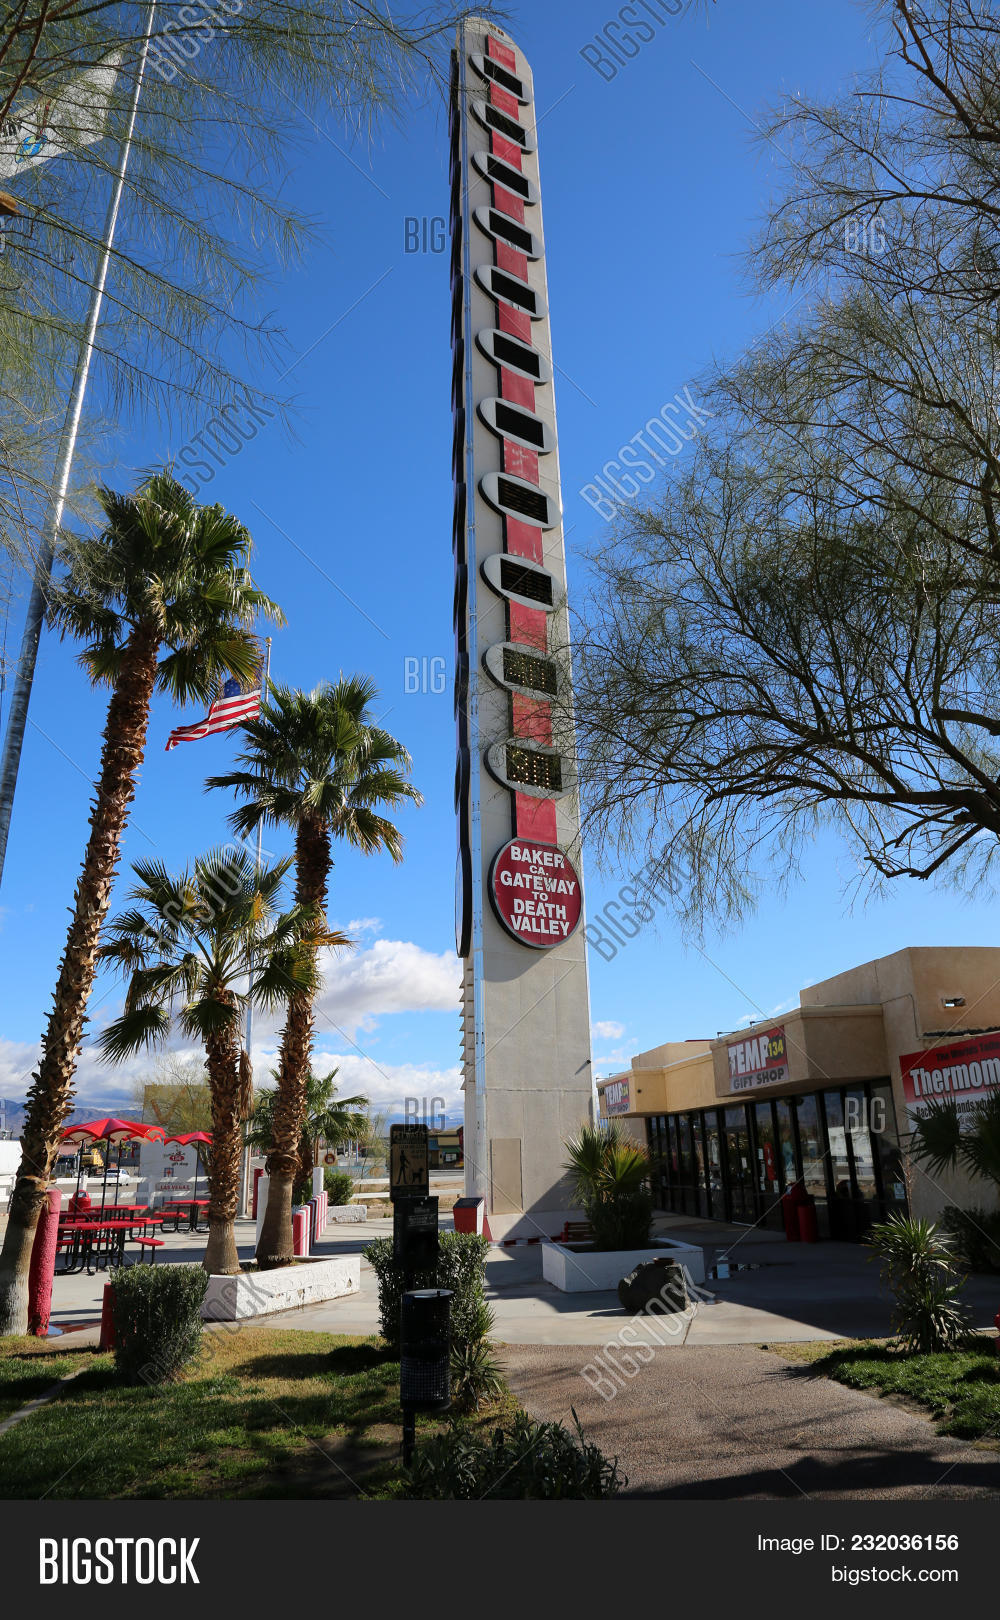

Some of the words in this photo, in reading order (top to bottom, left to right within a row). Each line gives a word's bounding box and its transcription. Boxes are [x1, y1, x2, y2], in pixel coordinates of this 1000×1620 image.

[510, 845, 565, 869] BAKER
[529, 865, 549, 876] CA.
[500, 870, 576, 895] GATEWAY
[531, 891, 549, 902] TO
[513, 898, 567, 920] DEATH
[510, 914, 570, 936] VALLEY
[728, 1036, 769, 1076] TEMP
[768, 1039, 784, 1057] 134
[733, 1075, 753, 1089] GIFT
[756, 1067, 785, 1085] SHOP
